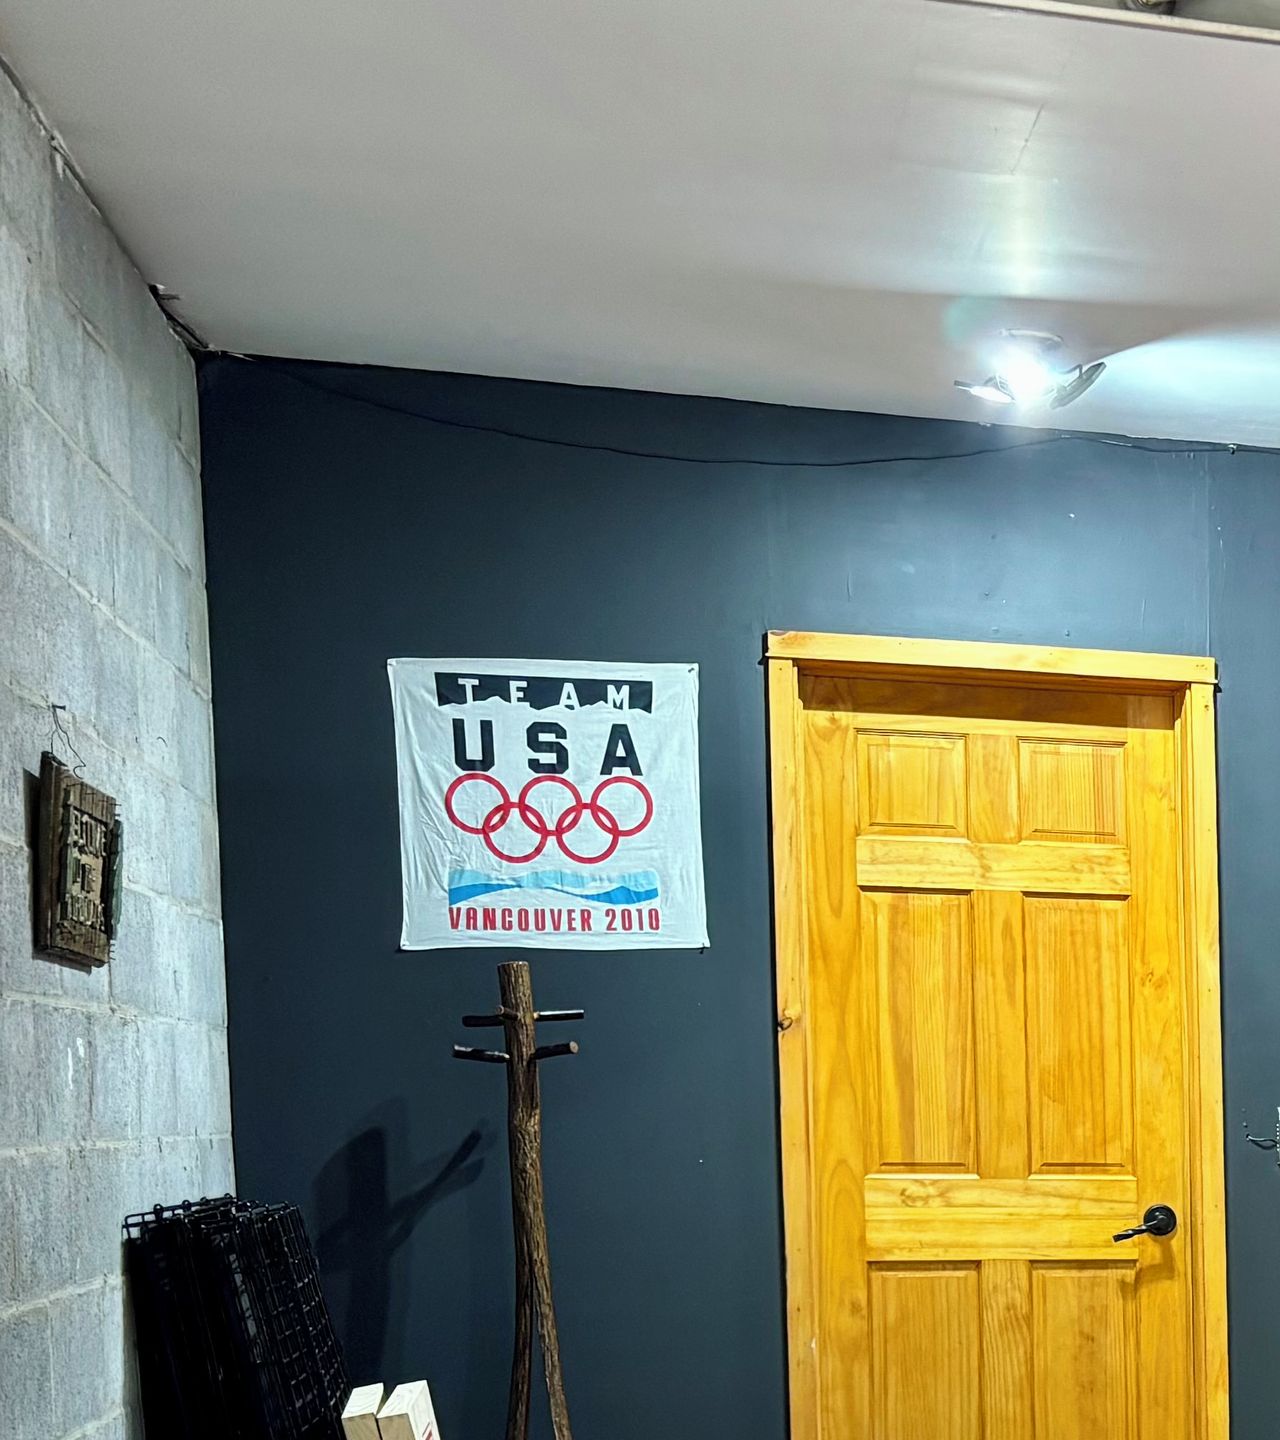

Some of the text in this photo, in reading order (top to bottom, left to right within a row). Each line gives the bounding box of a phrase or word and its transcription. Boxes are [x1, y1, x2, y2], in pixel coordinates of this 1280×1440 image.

[457, 677, 631, 710] TEAM
[452, 718, 643, 776] USA
[449, 907, 661, 932] VANCOUVER 2010
